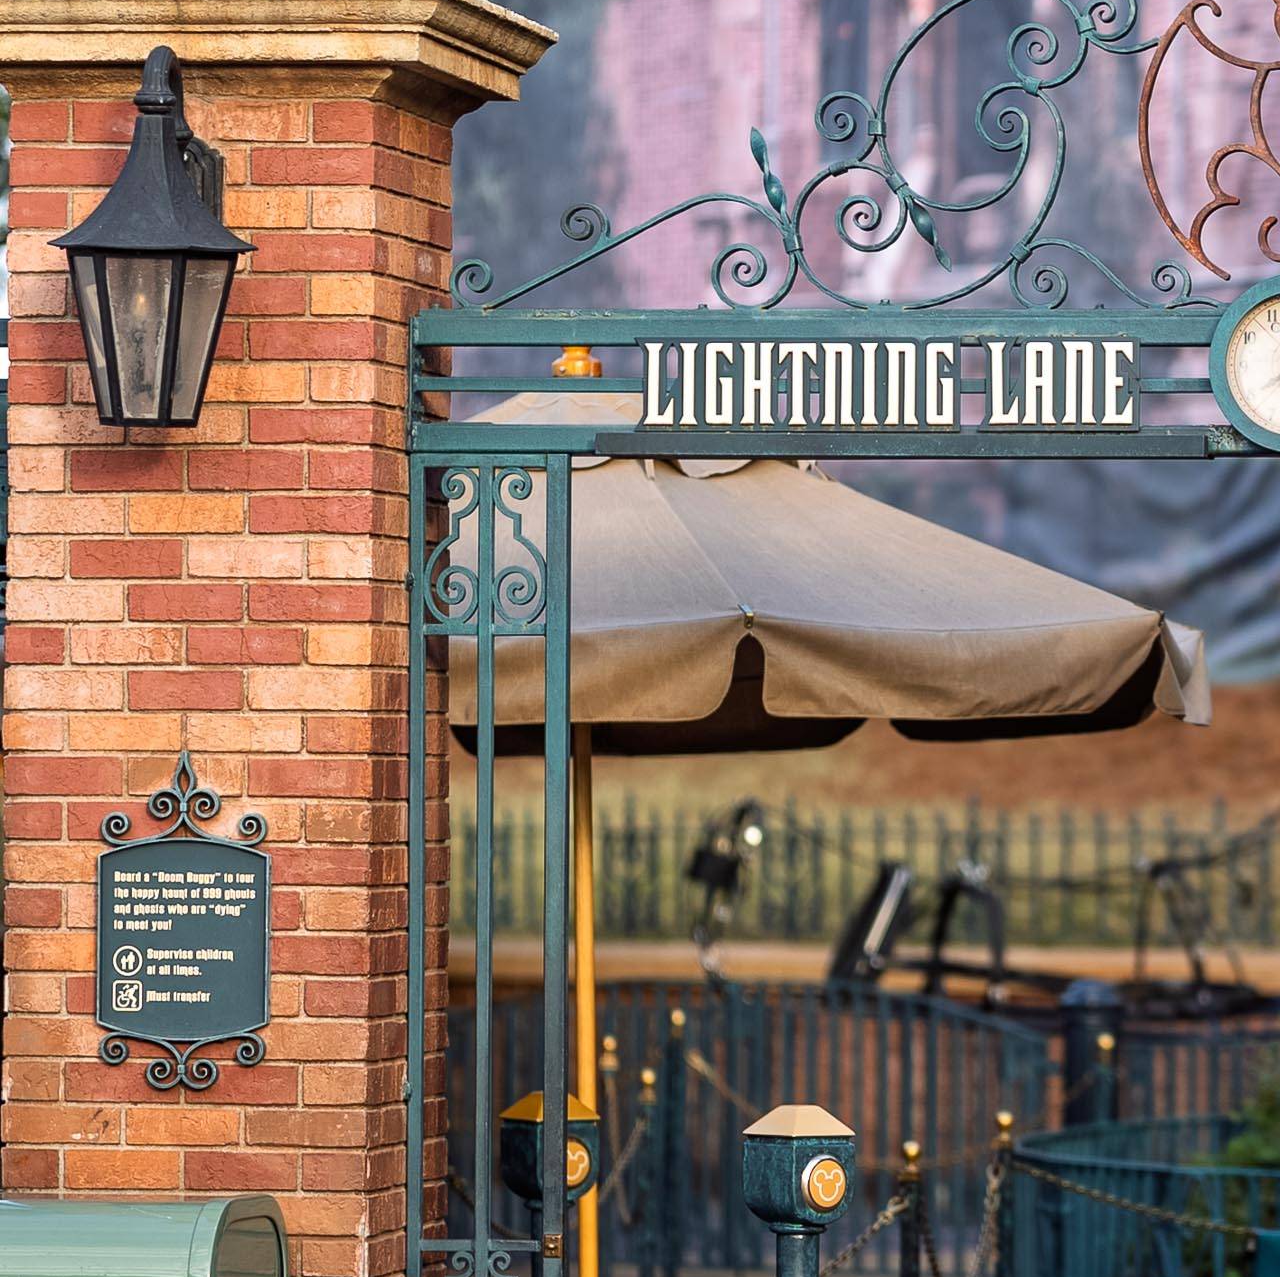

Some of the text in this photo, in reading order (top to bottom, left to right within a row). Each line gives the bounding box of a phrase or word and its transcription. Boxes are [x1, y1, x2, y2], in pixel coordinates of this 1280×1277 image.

[1267, 309, 1278, 323] 11
[643, 342, 1136, 426] LIGHTNING LANE
[115, 871, 141, 883] Board
[144, 873, 150, 883] a
[224, 873, 233, 883] to
[236, 873, 256, 883] tour
[114, 887, 256, 900] the happy haunt of 999 ghouls
[114, 903, 131, 915] and
[134, 903, 165, 916] ghosts
[167, 904, 188, 915] who
[191, 905, 207, 915] are
[114, 920, 123, 930] to
[126, 920, 149, 931] meet
[147, 949, 234, 962] Supervise children
[147, 965, 202, 976] at all times.
[146, 991, 211, 1003] Must transfer
